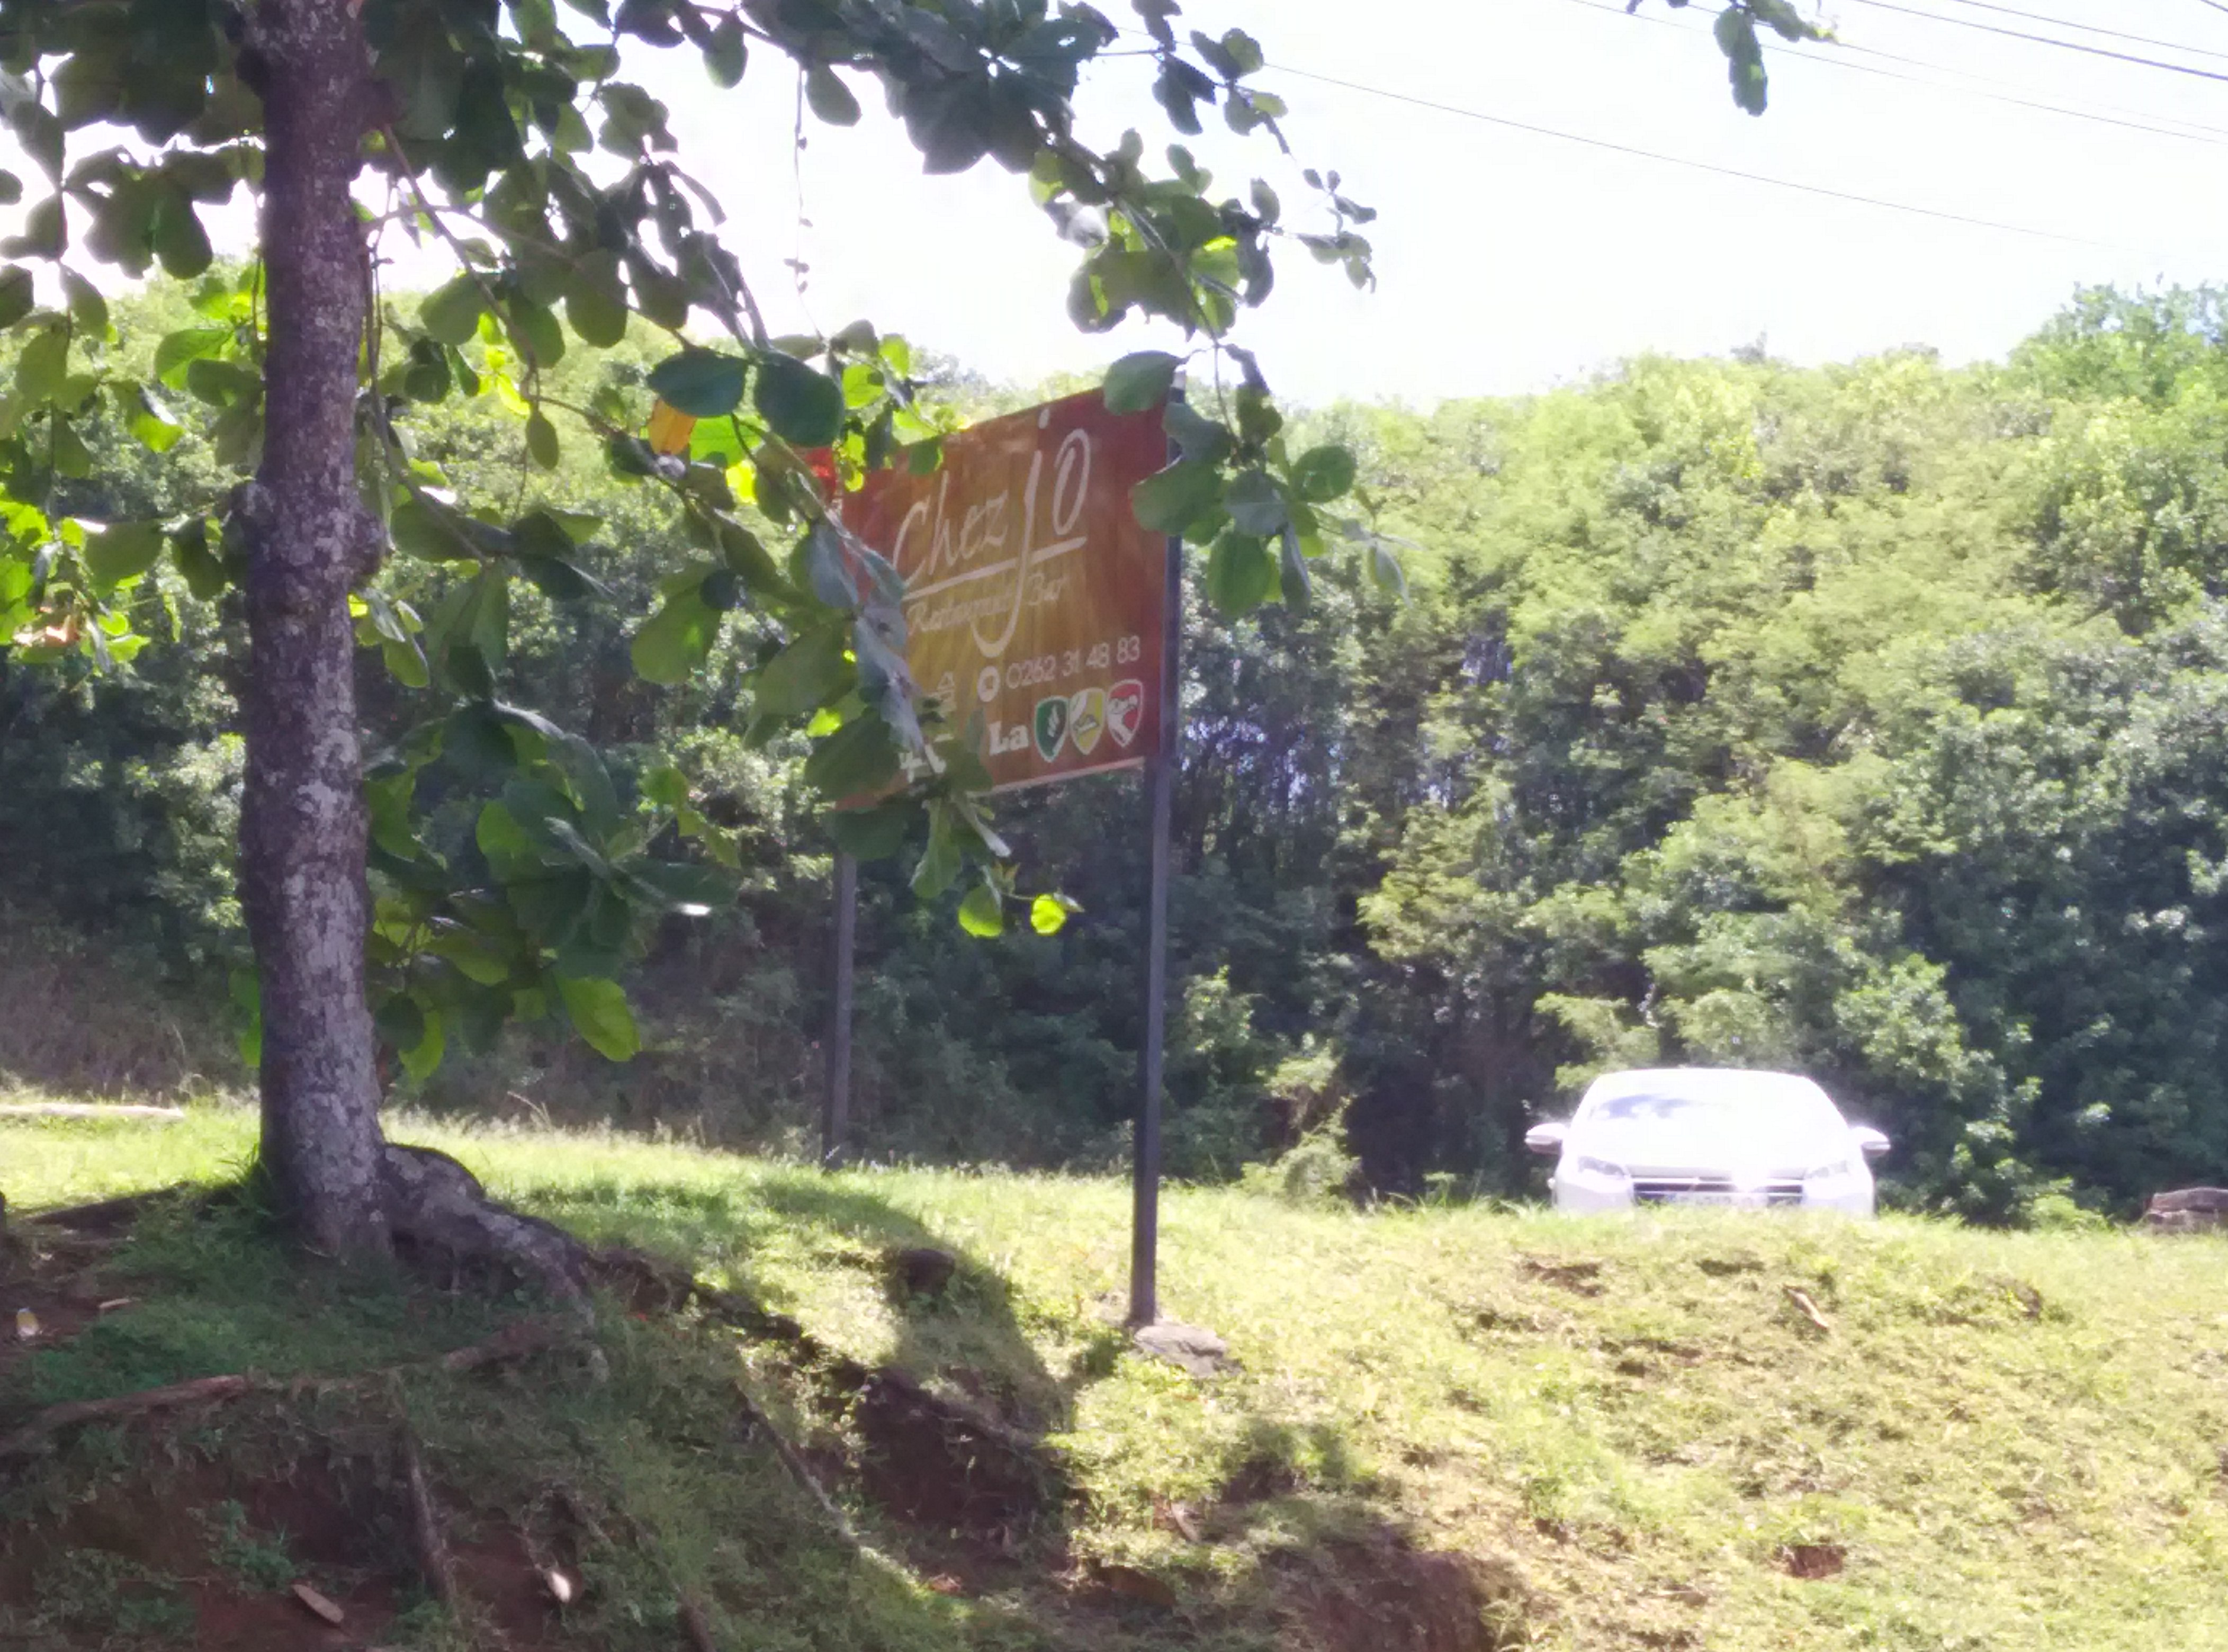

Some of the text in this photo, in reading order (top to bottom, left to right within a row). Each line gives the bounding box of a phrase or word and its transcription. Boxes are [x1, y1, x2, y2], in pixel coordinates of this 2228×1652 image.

[892, 470, 1009, 590] Chez
[1027, 572, 1072, 606] Bar
[1007, 635, 1140, 689] 0262 31 48 83
[989, 721, 1030, 756] La
